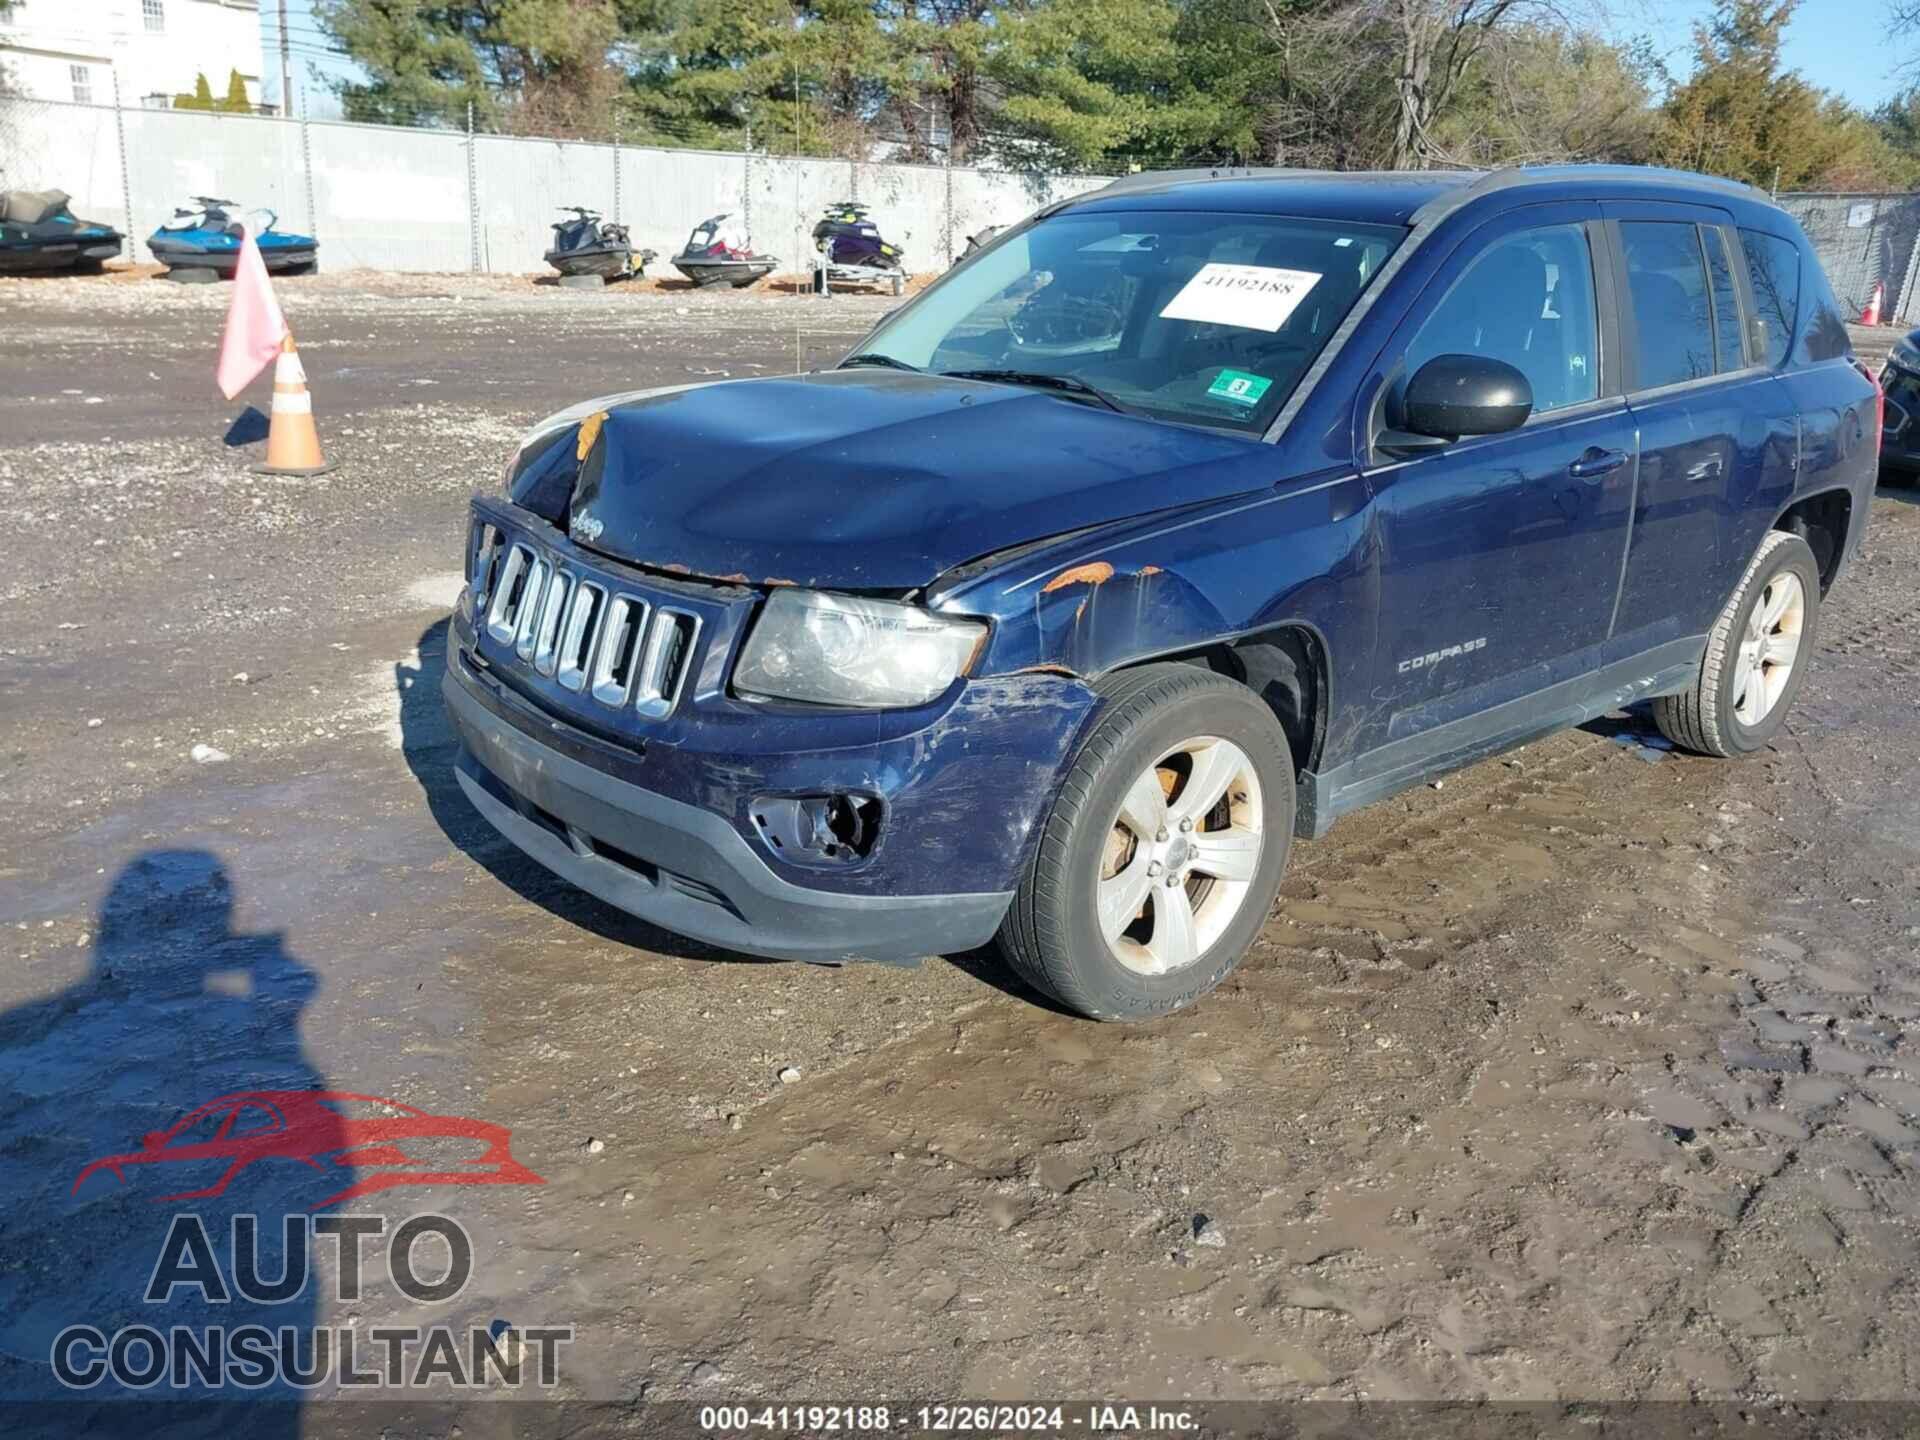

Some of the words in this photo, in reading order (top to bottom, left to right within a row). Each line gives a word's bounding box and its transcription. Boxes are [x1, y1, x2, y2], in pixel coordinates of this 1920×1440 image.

[1233, 380, 1246, 392] 3
[570, 508, 604, 542] Jeep
[1398, 637, 1487, 673] COMPASS
